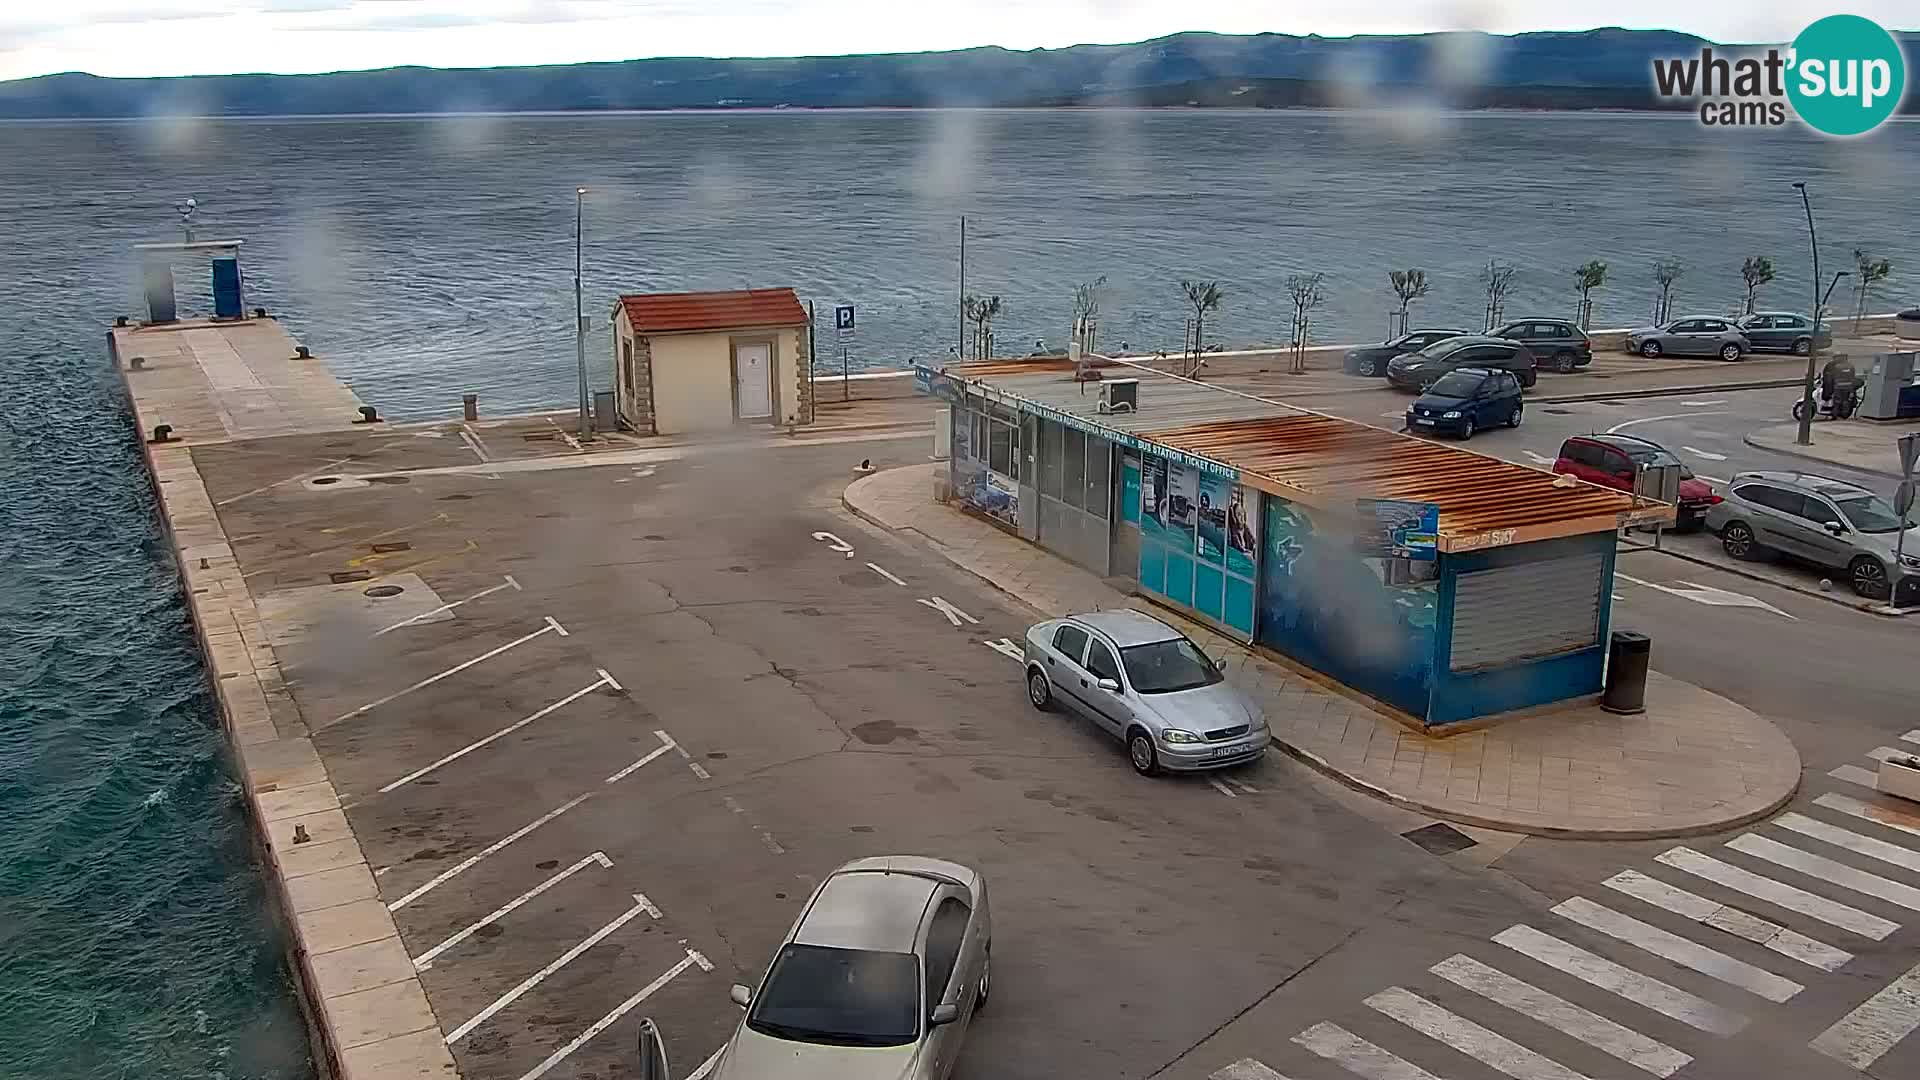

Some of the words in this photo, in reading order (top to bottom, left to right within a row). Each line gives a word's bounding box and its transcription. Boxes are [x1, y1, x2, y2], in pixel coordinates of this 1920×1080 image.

[840, 309, 851, 326] P
[1137, 440, 1152, 452] BUS
[1152, 445, 1182, 462] STATION
[1184, 456, 1208, 471] TICKET
[1209, 464, 1235, 479] OFFICE
